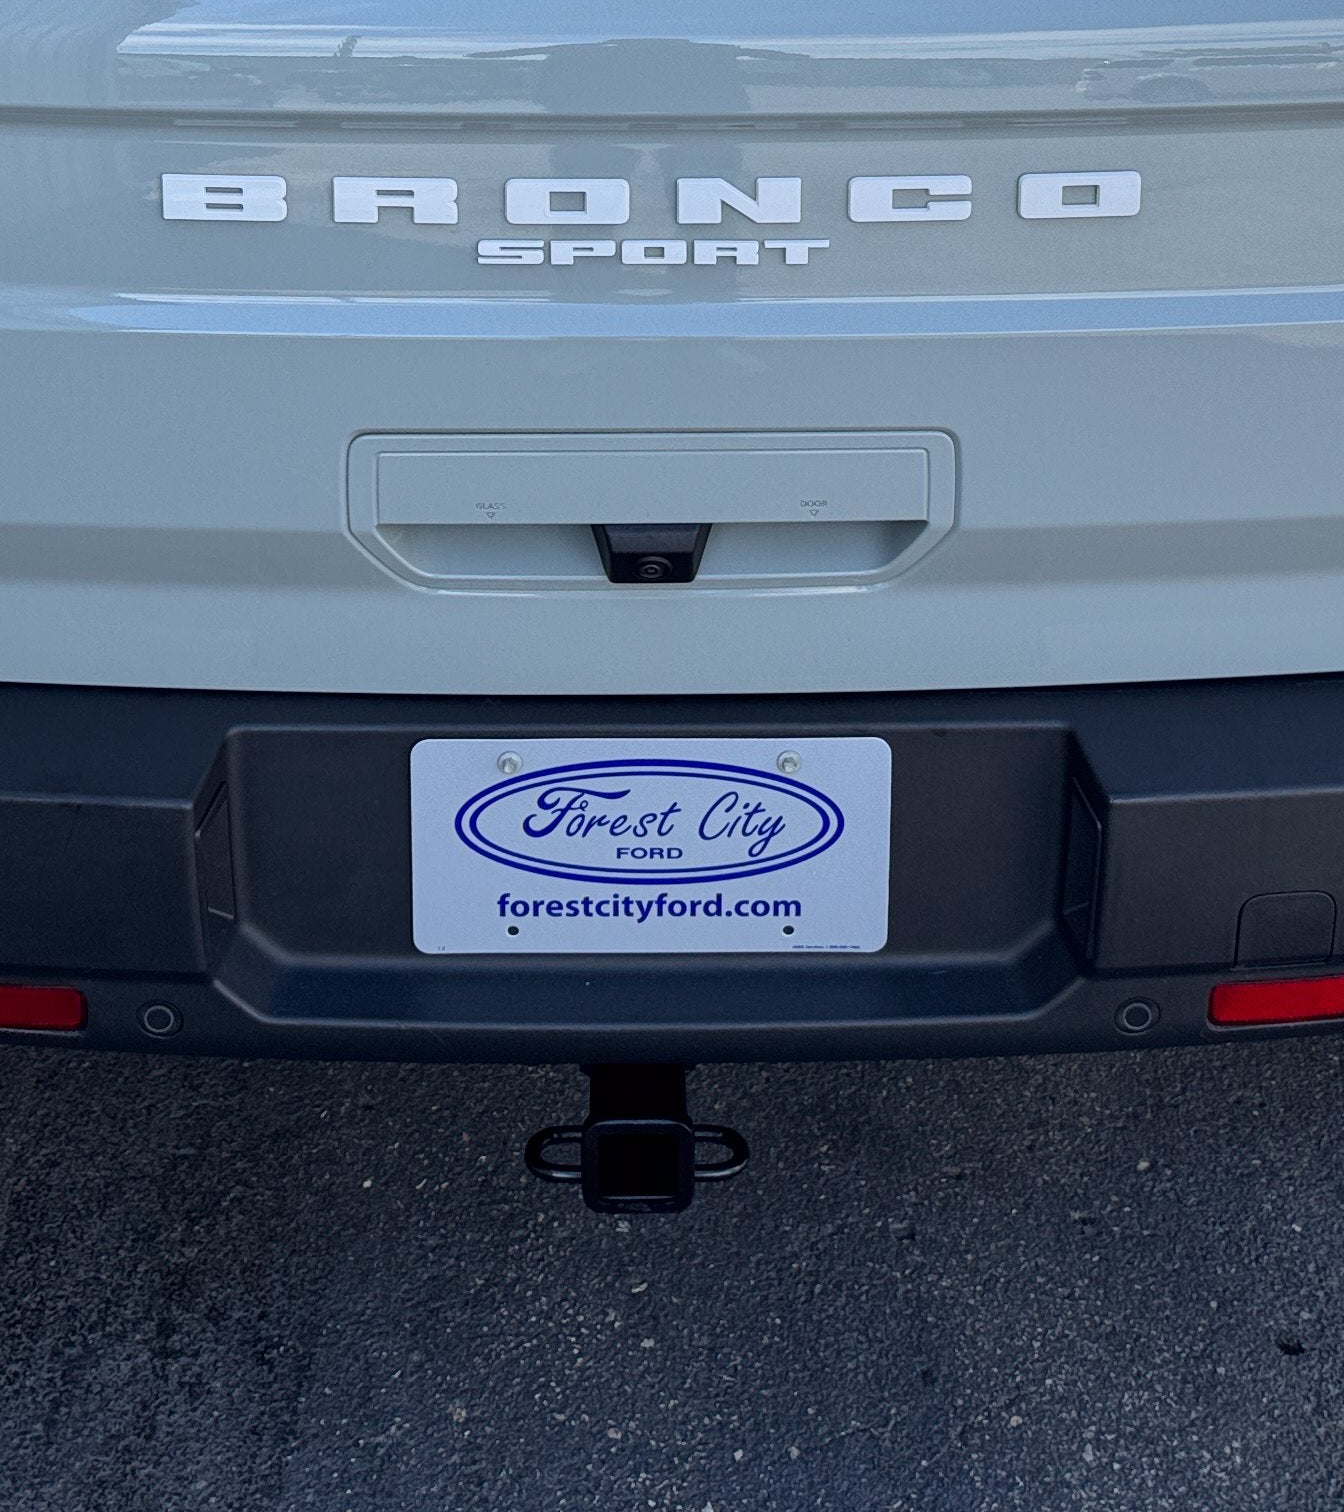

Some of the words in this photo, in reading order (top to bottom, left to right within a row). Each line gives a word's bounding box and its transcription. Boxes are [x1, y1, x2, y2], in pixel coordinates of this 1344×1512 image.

[161, 170, 1142, 225] BRONCO
[476, 239, 831, 266] SPORT
[522, 787, 683, 838] Forest
[697, 791, 787, 858] City
[616, 846, 684, 860] FORD
[497, 892, 802, 924] forestcityford.com
